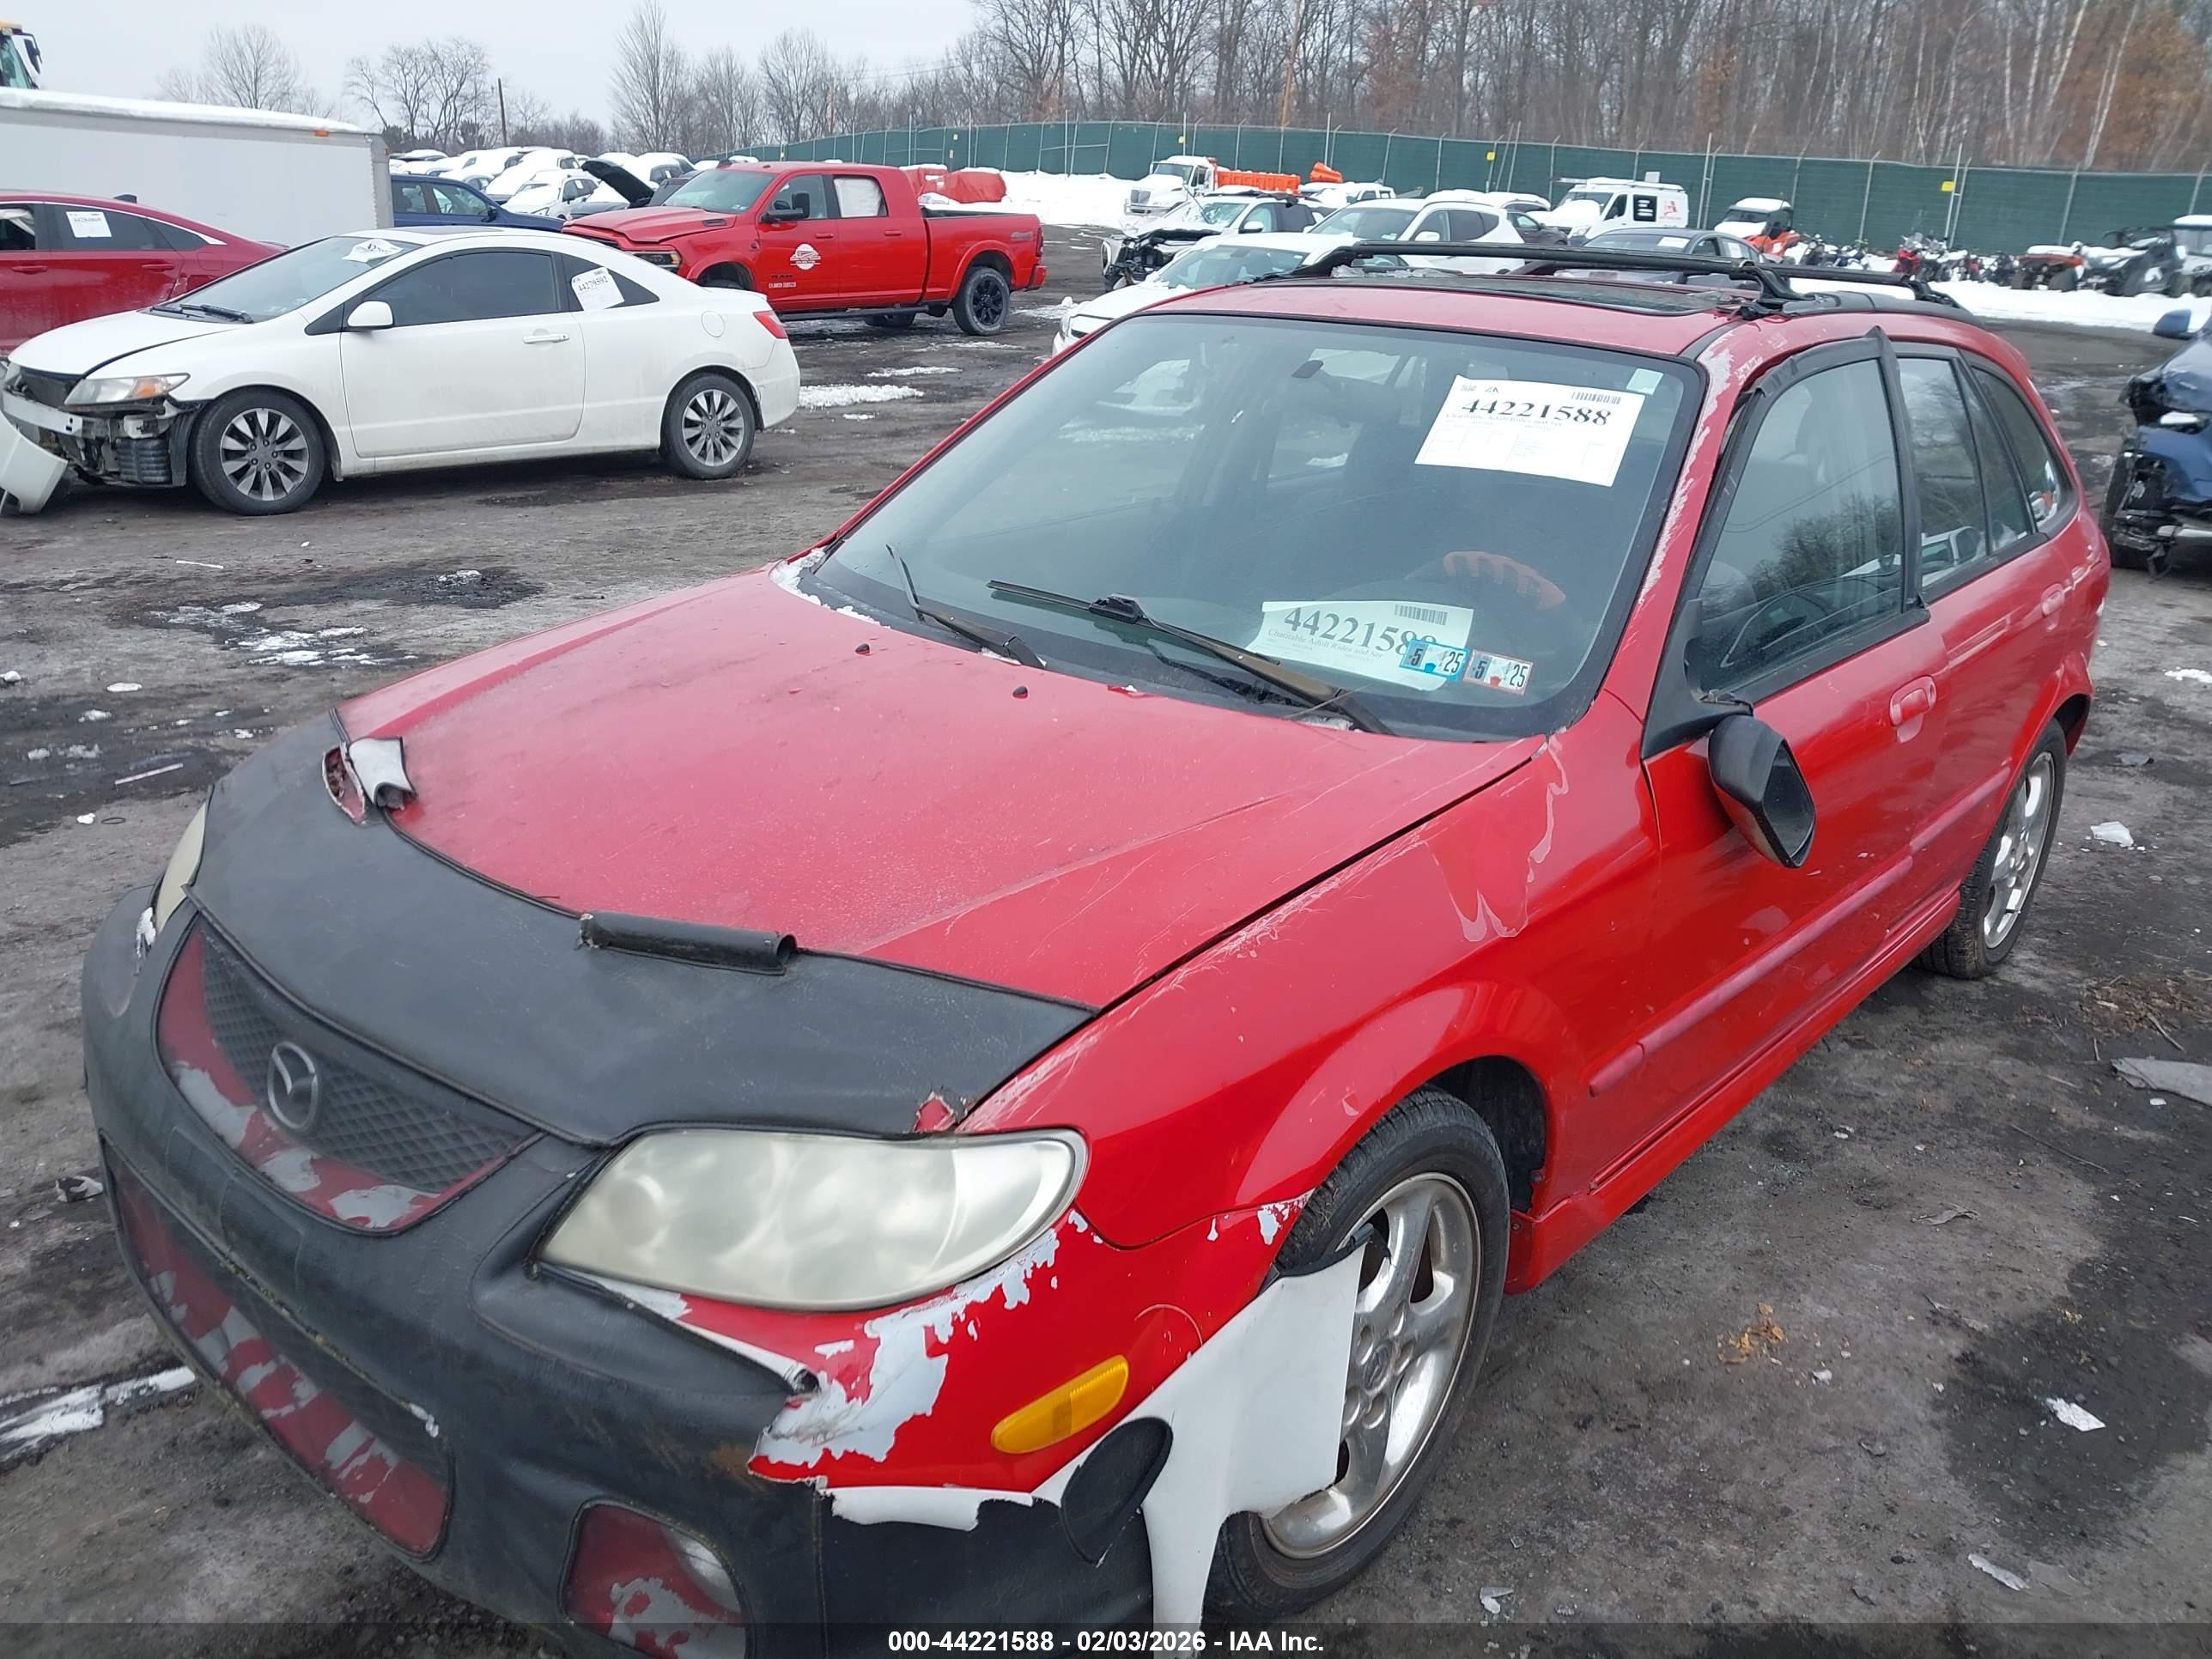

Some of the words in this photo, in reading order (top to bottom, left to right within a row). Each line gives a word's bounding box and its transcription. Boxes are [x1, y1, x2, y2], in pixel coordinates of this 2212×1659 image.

[1462, 398, 1612, 426] 44221588
[1268, 629, 1307, 642] Charitable
[1309, 635, 1329, 647] Adult
[1410, 648, 1423, 666] 5
[1443, 651, 1464, 673] 25
[1474, 659, 1487, 679] 5
[1510, 664, 1528, 688] 25
